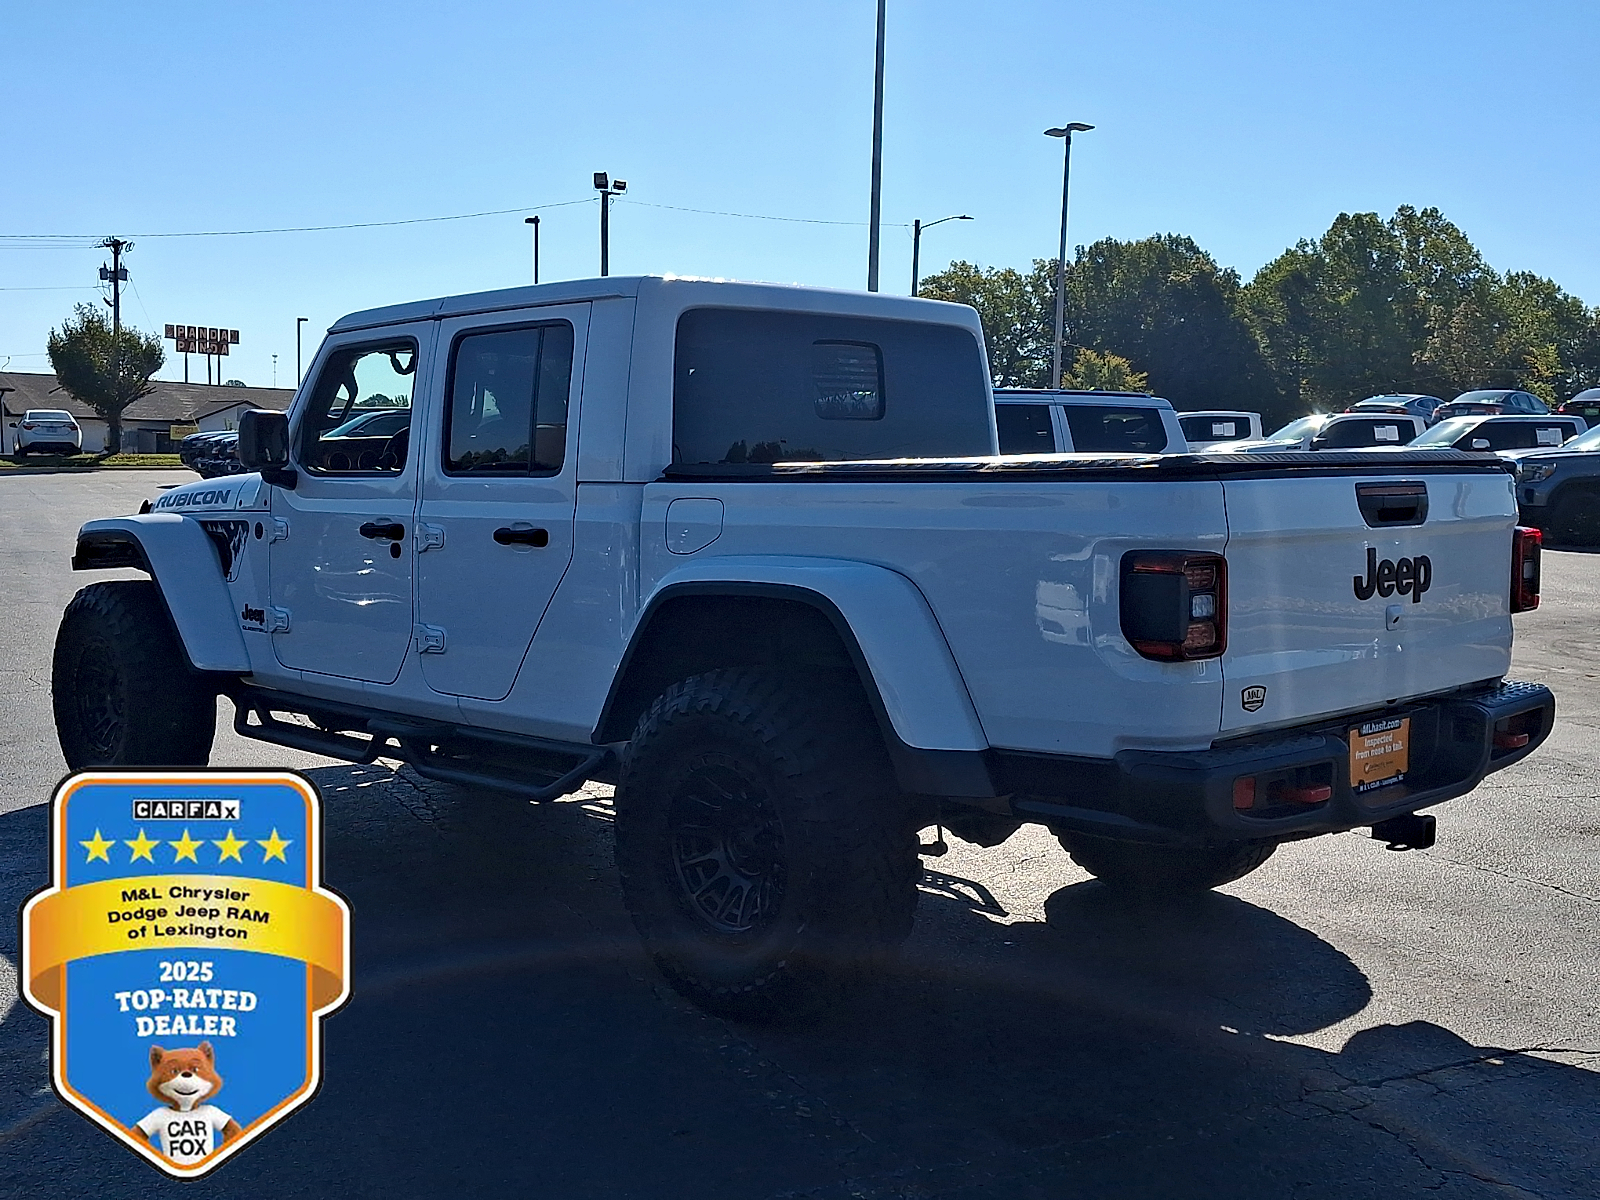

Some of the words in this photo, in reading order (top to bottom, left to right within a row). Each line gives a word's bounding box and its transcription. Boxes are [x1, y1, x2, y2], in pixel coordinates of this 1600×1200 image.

[177, 326, 228, 341] PANDA
[177, 341, 228, 355] PANDA
[155, 490, 231, 508] RUBICON
[1353, 547, 1432, 604] Jeep
[241, 603, 265, 626] Jeep
[1364, 733, 1393, 747] Inspected
[1355, 750, 1370, 760] from
[1385, 744, 1392, 752] to
